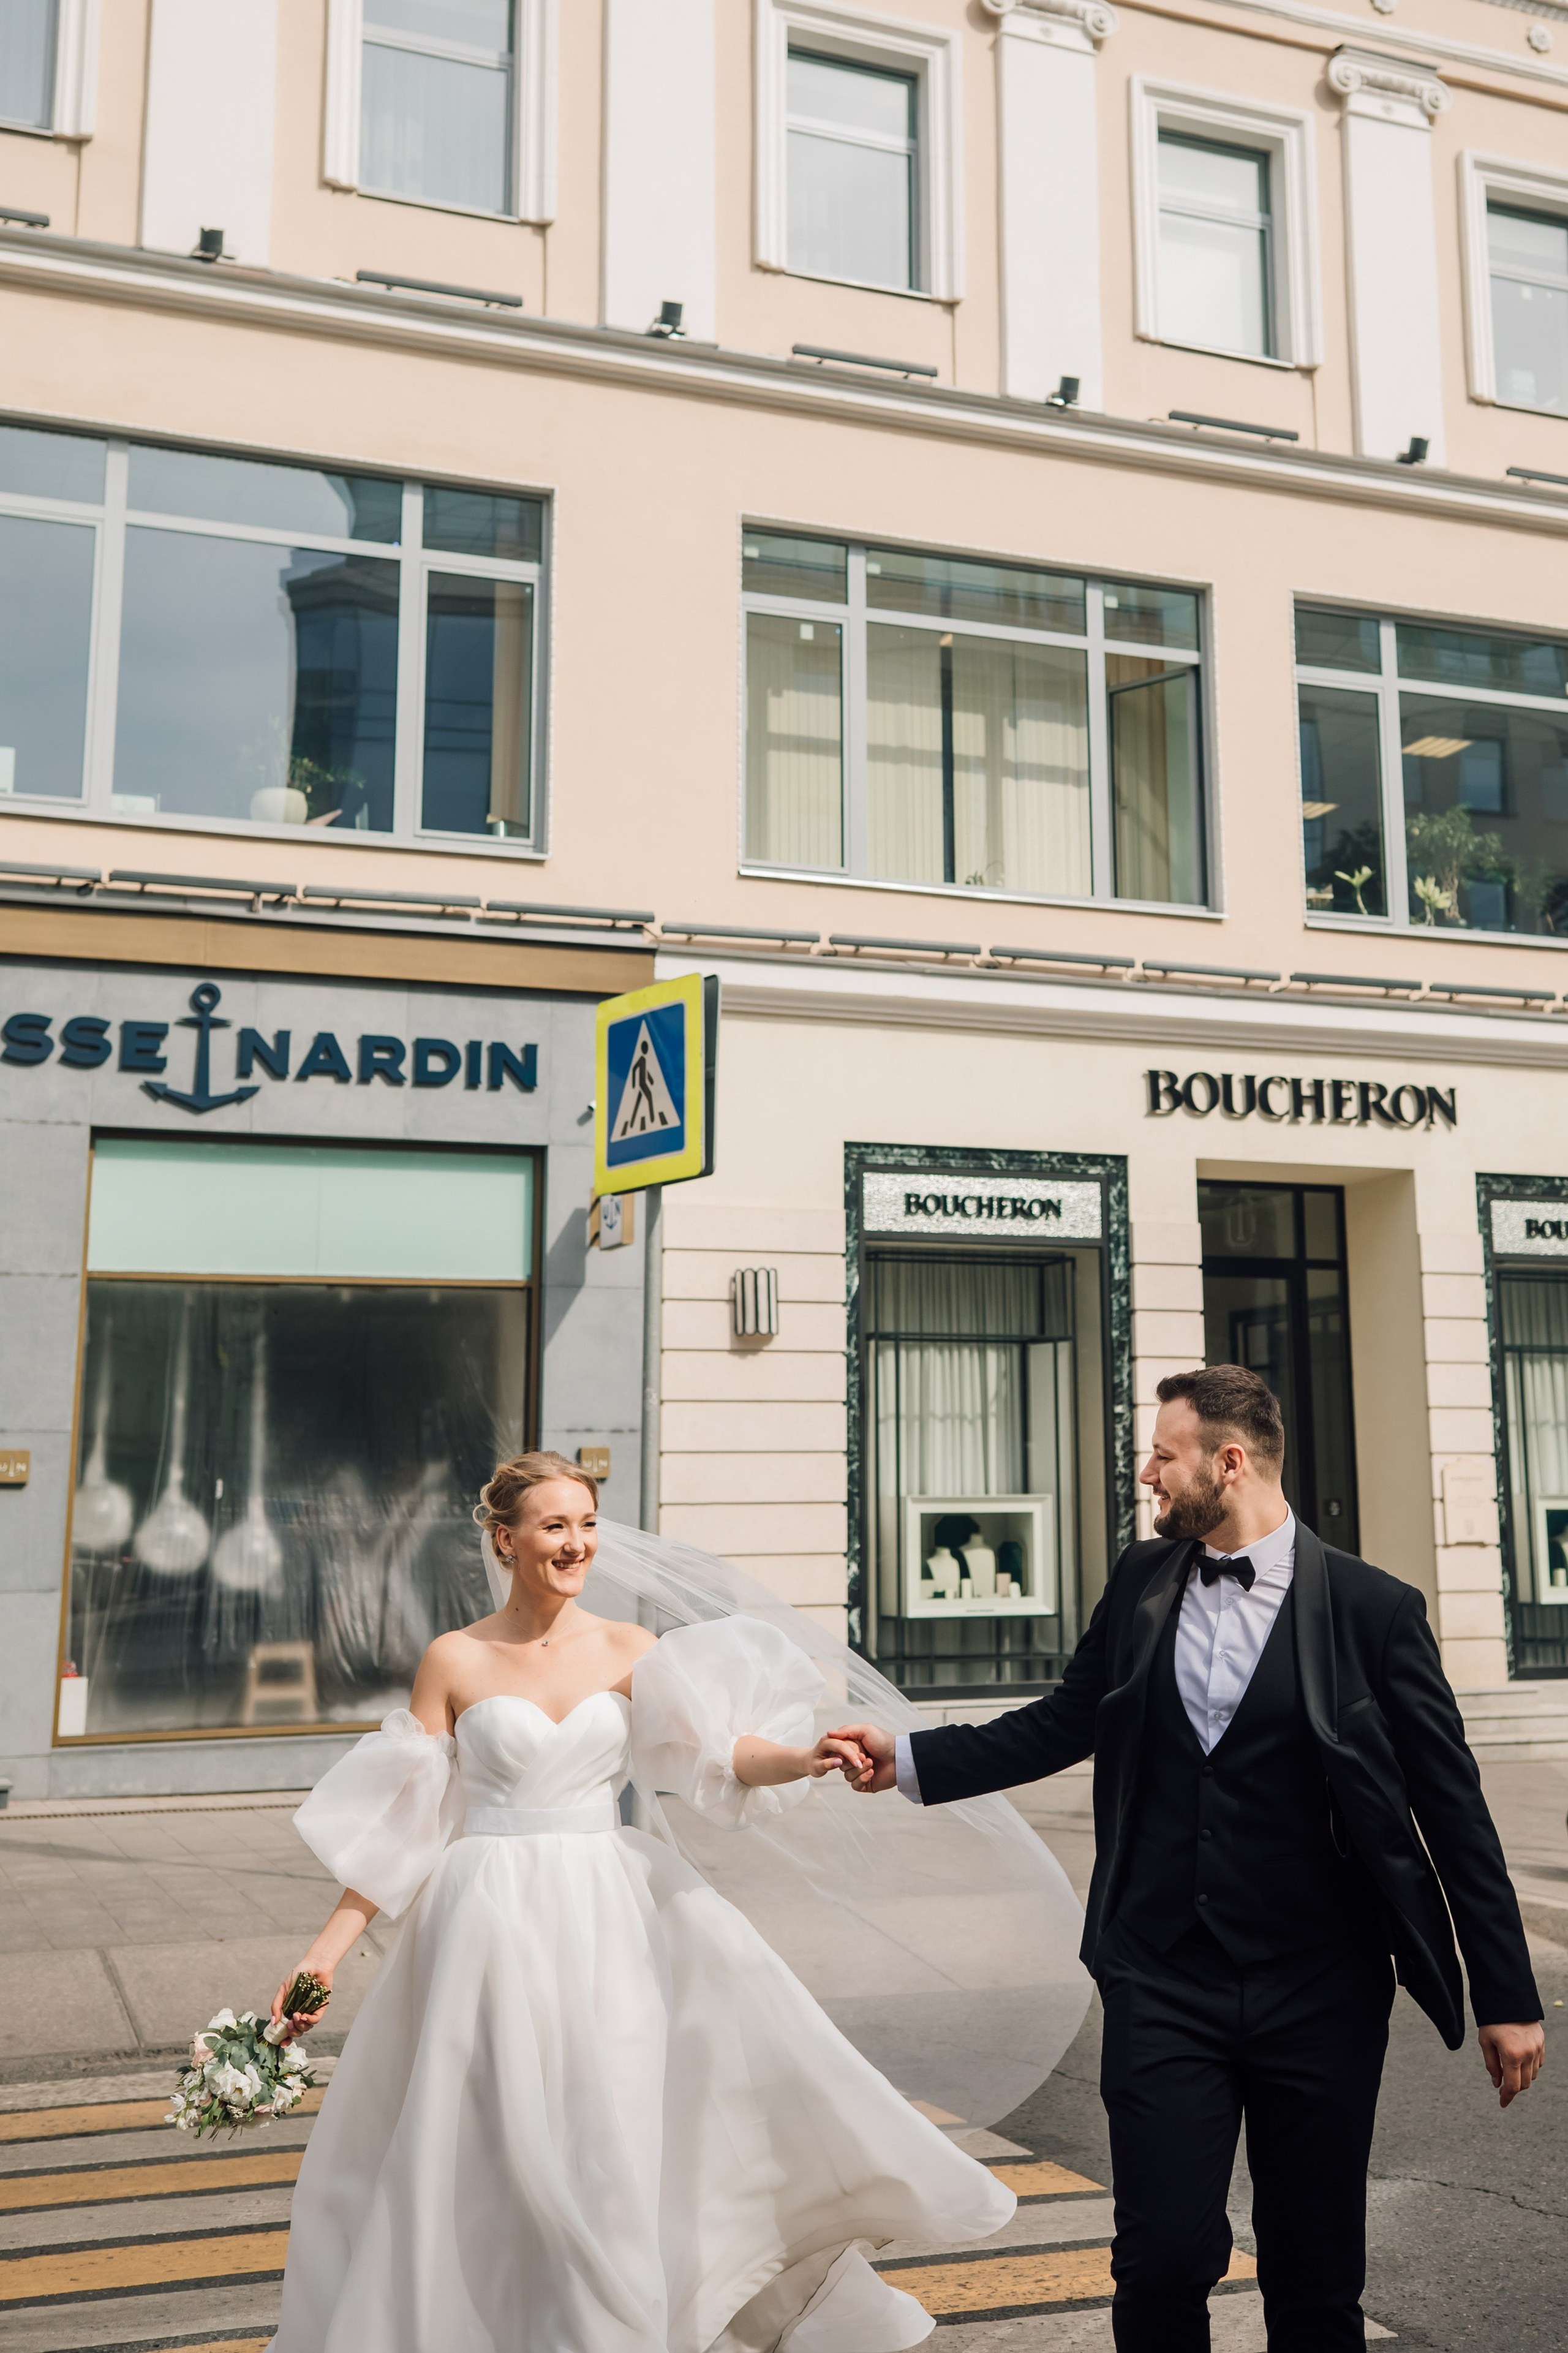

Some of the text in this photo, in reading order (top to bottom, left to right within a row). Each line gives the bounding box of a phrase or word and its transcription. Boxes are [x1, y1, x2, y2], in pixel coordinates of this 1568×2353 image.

[1, 1013, 538, 1091] SSE NARDIN
[1147, 1070, 1457, 1126] BOUCHERON
[905, 1192, 1061, 1220] BOUCHERON
[1525, 1218, 1568, 1241] BOU
